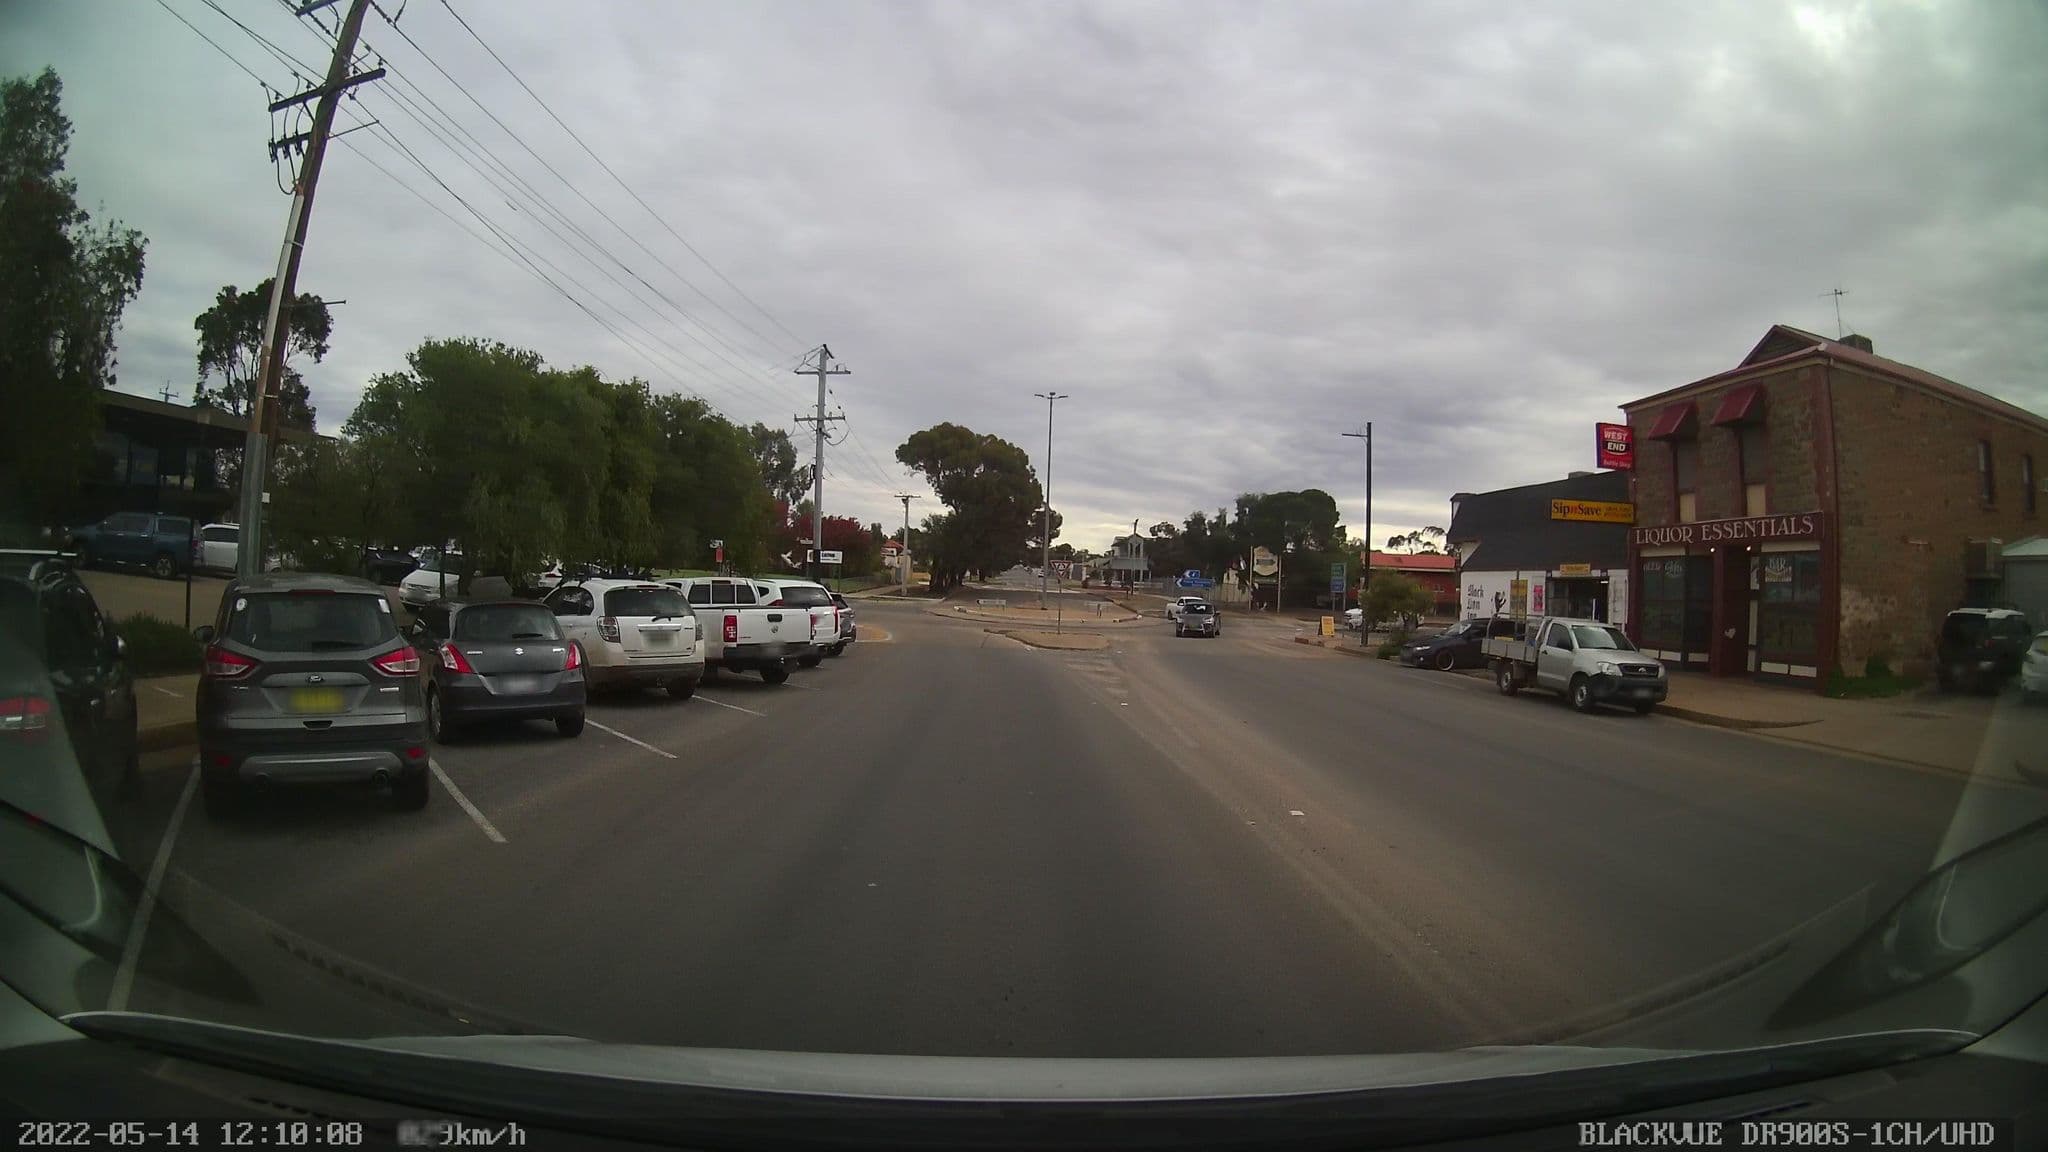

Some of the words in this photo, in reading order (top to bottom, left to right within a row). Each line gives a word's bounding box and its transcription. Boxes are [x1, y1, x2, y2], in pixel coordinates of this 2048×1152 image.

[1604, 430, 1628, 441] WEST
[1607, 442, 1626, 452] END
[1636, 527, 1694, 546] LIQUOR
[1702, 515, 1814, 541] ESSENTIALS
